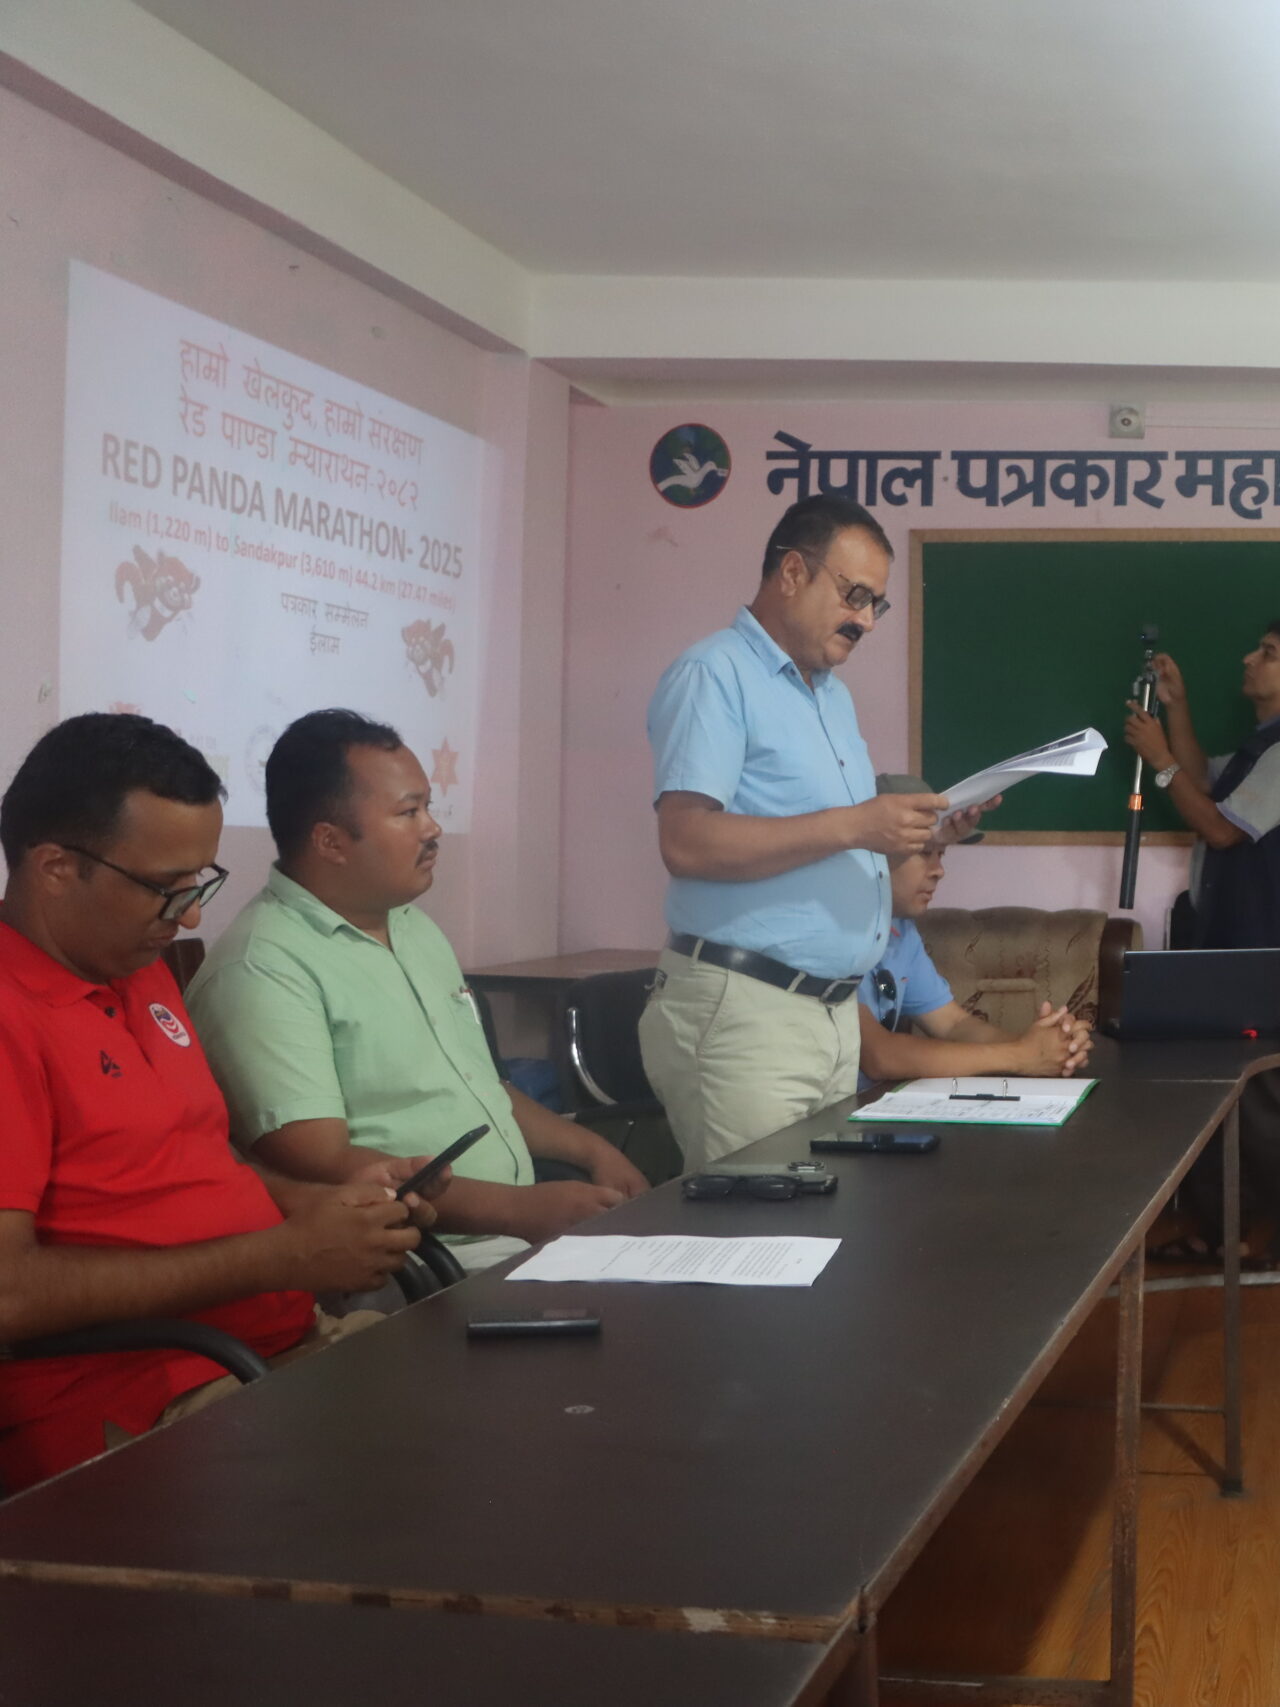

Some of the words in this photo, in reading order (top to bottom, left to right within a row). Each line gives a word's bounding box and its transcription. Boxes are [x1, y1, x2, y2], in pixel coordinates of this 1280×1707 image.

[179, 384, 209, 438] रेड
[221, 411, 278, 462] पाण्डा
[180, 339, 230, 390] हाम्रो
[324, 400, 365, 443] हाम्रो
[102, 432, 162, 490] RED
[172, 454, 266, 524] PANDA
[418, 535, 464, 579] 2025
[766, 430, 941, 507] नेपाल
[951, 450, 1168, 510] पत्रकार
[109, 501, 142, 529] Ilam
[146, 510, 191, 542] (1,220
[194, 526, 212, 552] m)
[216, 532, 229, 552] to
[234, 535, 298, 569] Sandakpur
[300, 552, 336, 580] (3,610
[355, 569, 377, 591] 44.2
[379, 575, 396, 595] km
[281, 592, 318, 620] पत्रकार
